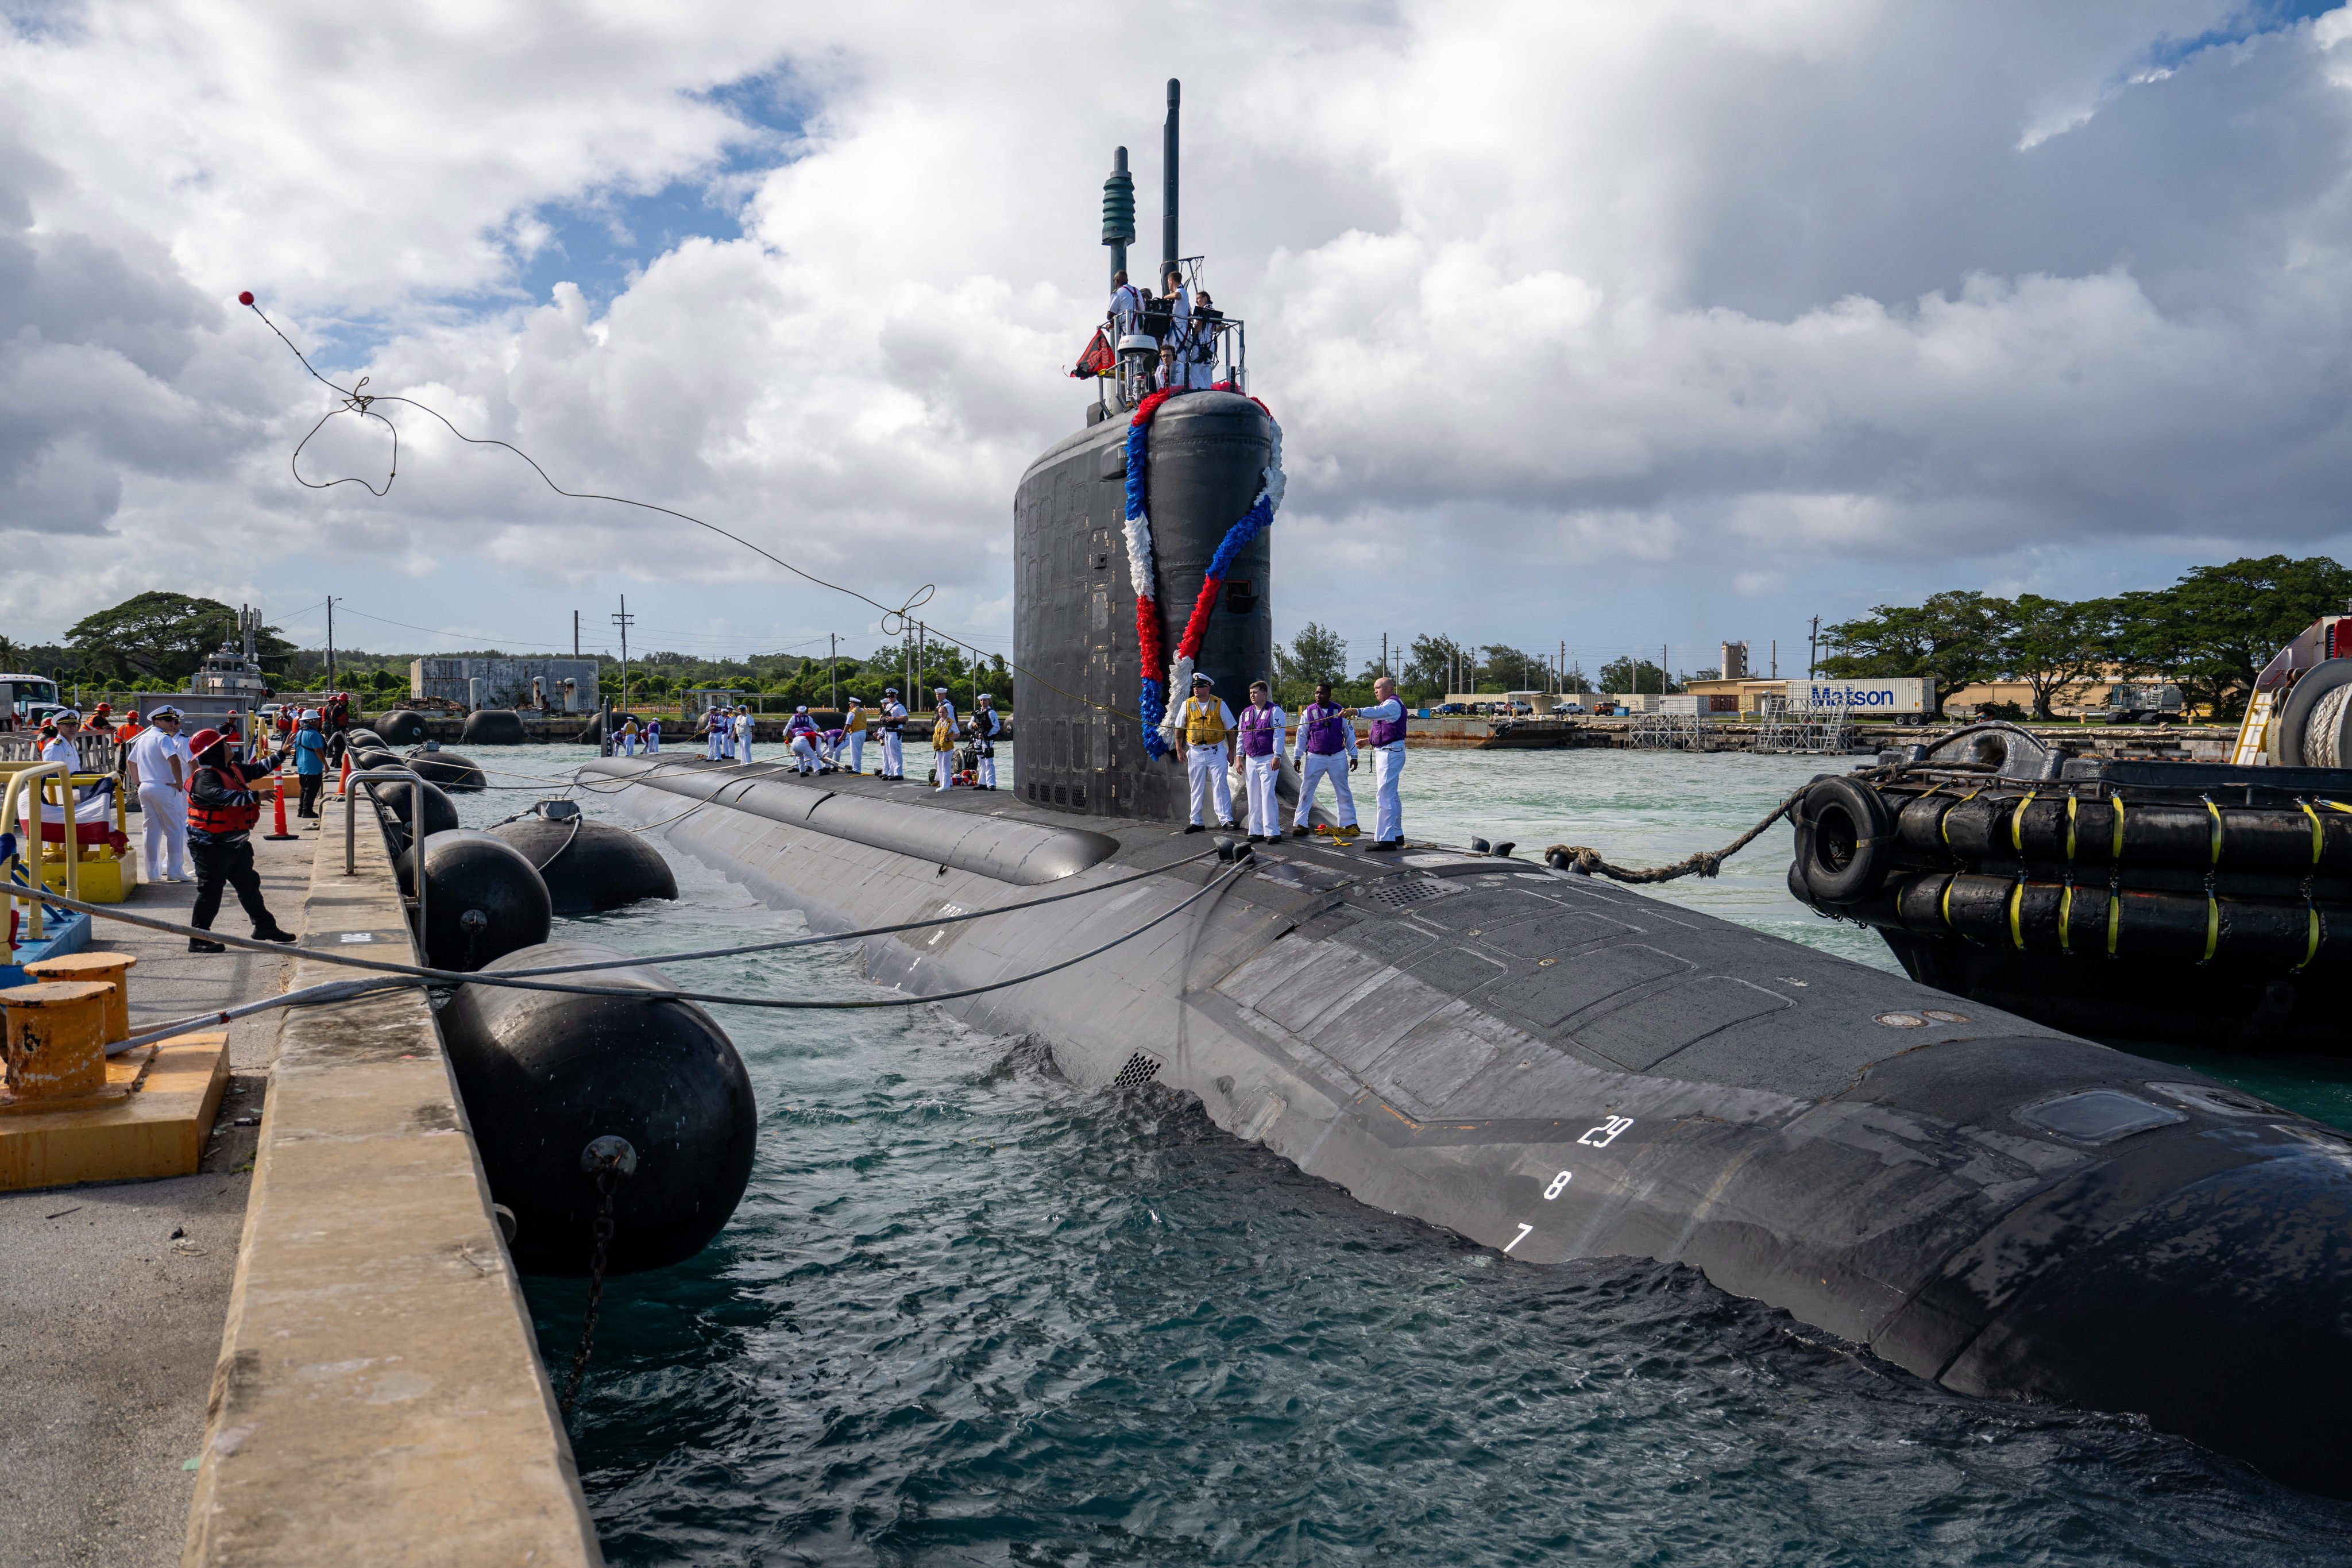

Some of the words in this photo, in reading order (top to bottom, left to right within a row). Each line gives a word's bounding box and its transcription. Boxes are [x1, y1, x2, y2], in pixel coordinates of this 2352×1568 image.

[1812, 685, 1894, 706] Matson
[939, 903, 968, 917] PRO
[341, 933, 372, 943] 500
[928, 930, 945, 945] 30
[909, 957, 921, 971] 9
[1577, 1115, 1633, 1148] 29
[1543, 1171, 1572, 1200] 8
[1503, 1222, 1534, 1253] 7
